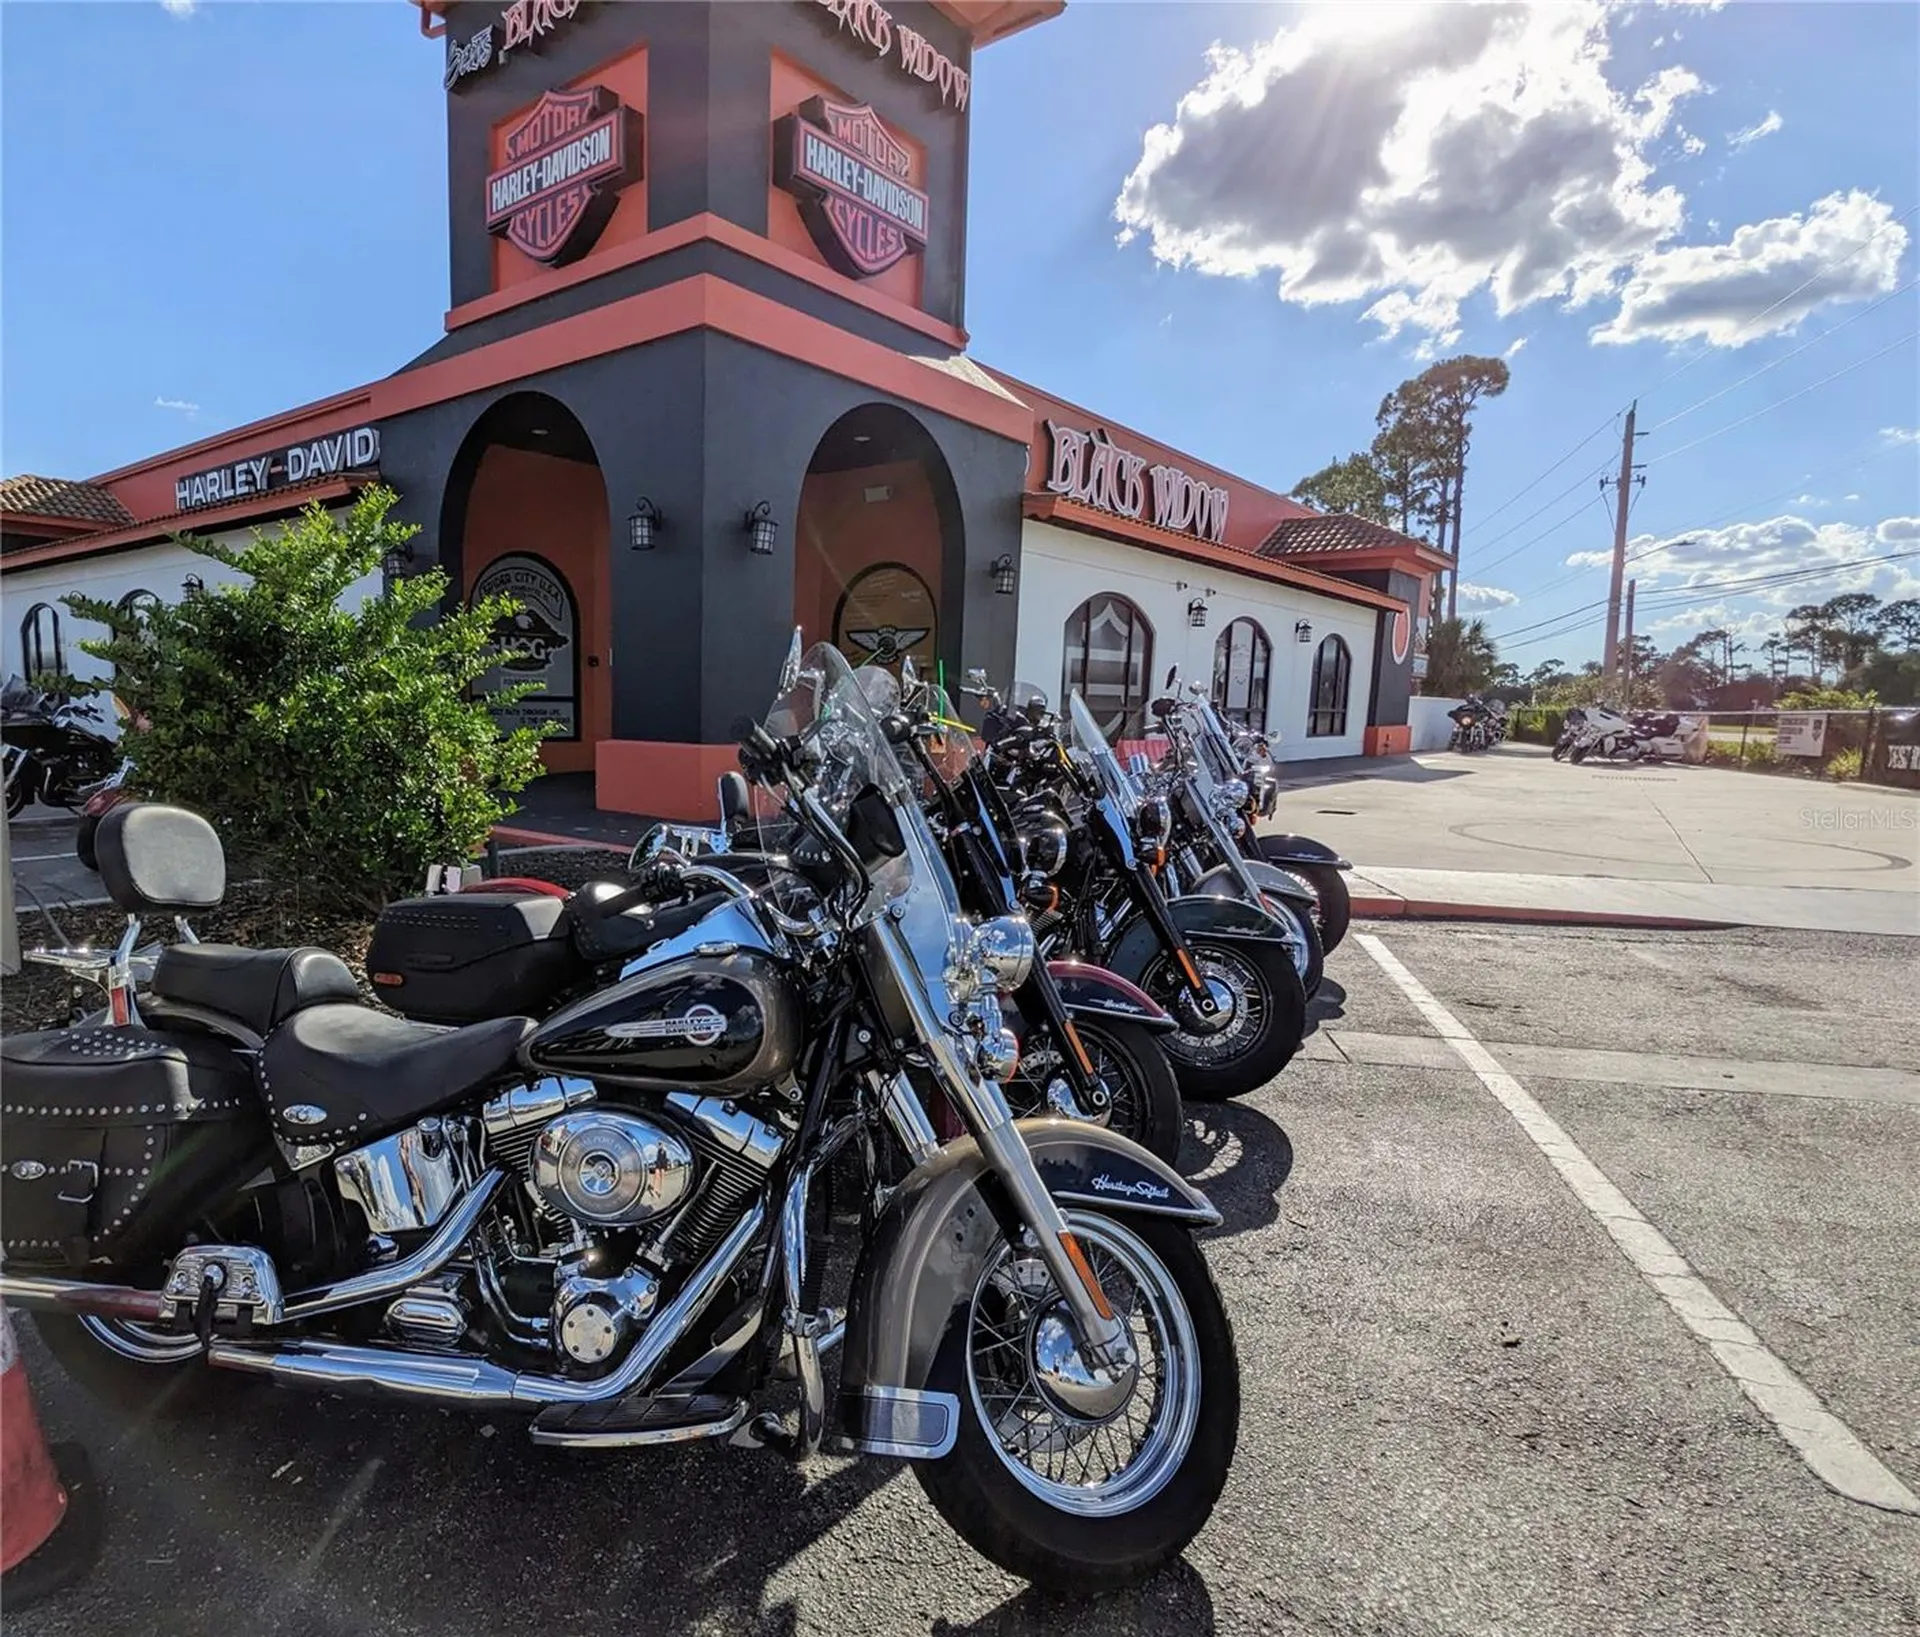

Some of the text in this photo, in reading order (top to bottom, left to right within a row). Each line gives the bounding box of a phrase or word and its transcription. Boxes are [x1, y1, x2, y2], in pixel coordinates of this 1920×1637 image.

[896, 24, 970, 112] WIDOW
[516, 102, 580, 152] MOTOR
[837, 115, 902, 174] MOTOR
[491, 125, 611, 214] HARLEY-DAVIDSON
[805, 134, 924, 231] HARLEY-DAVIDSON
[515, 188, 581, 248] CYCLES
[833, 199, 898, 261] CYCLES
[1047, 419, 1229, 543] BLACK WIDOW
[515, 571, 537, 585] CITY
